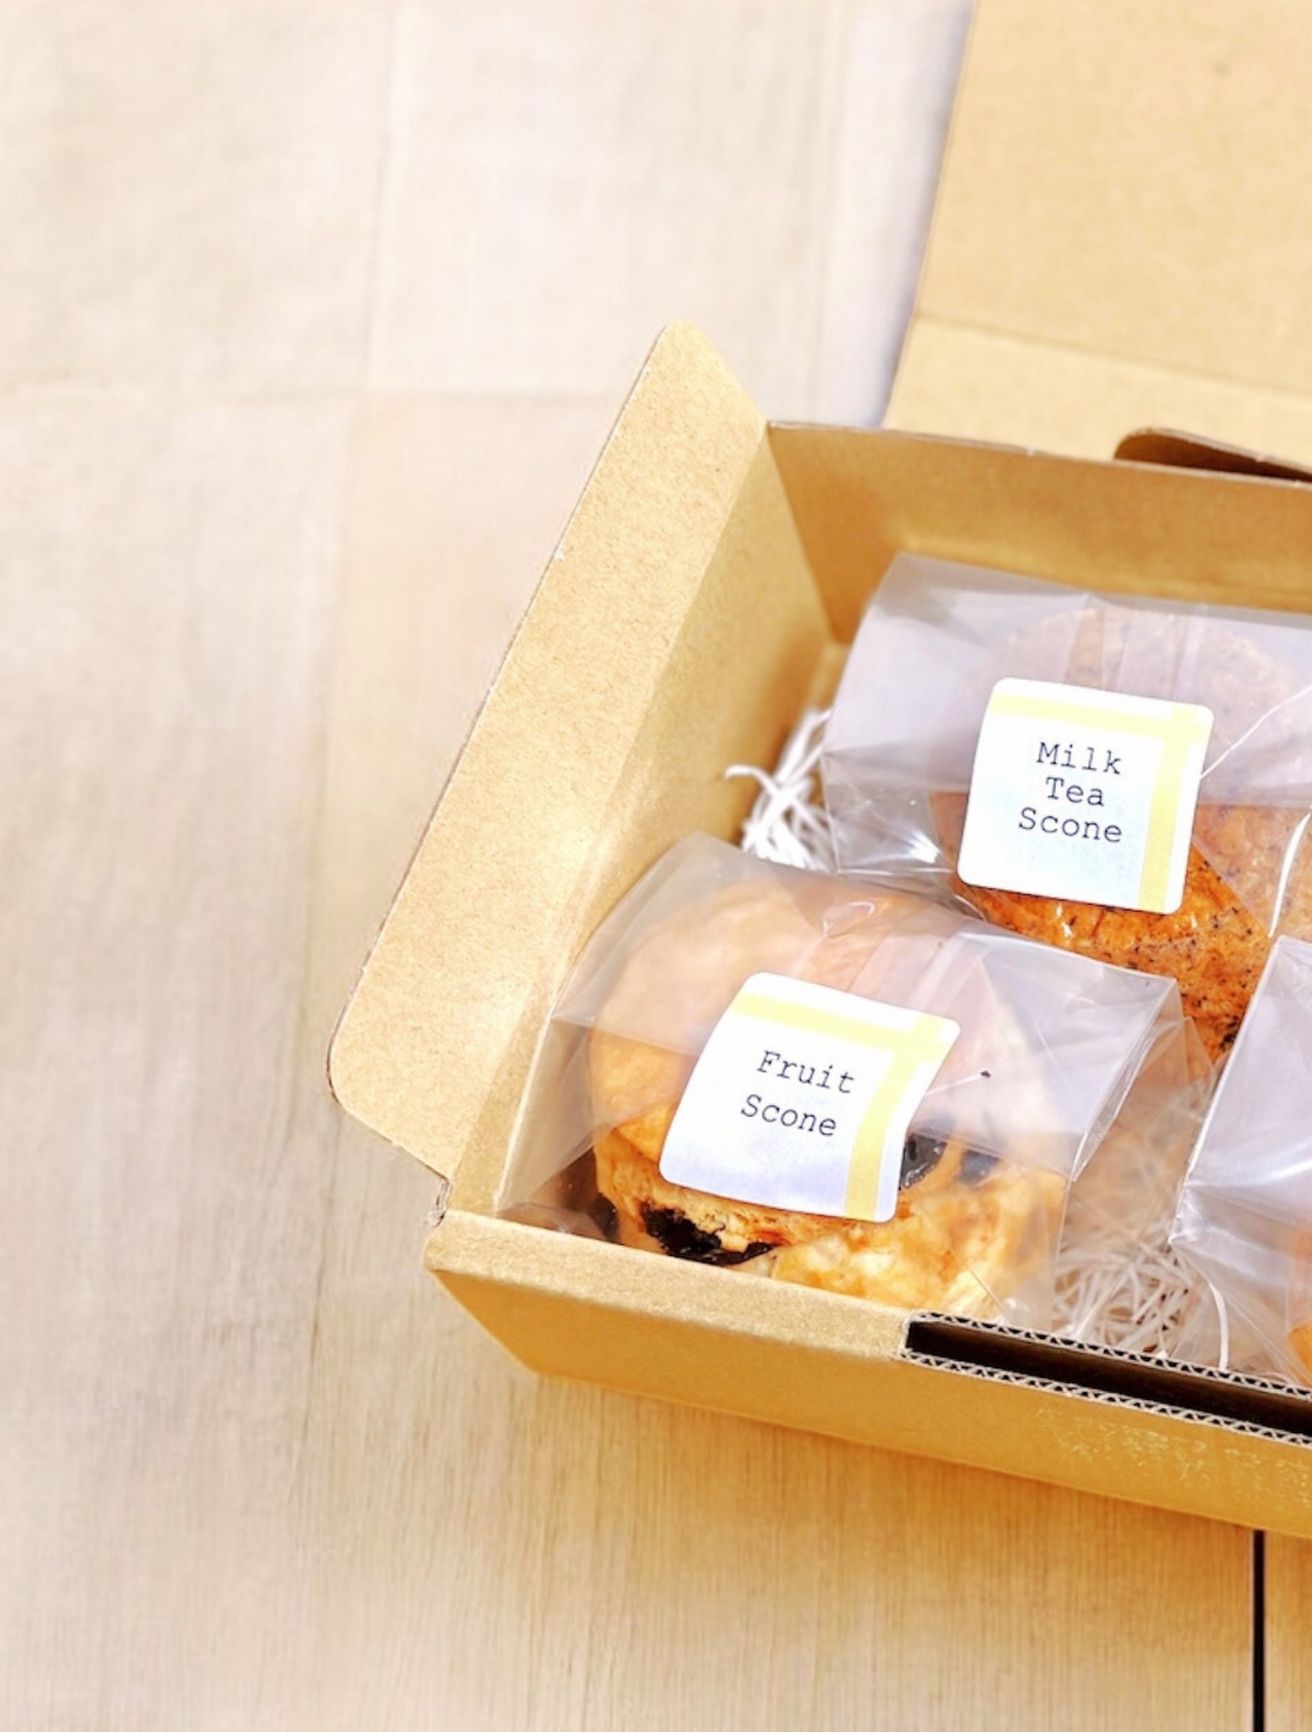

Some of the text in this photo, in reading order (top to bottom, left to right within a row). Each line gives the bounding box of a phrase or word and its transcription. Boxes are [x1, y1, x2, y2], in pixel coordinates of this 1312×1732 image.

[1036, 741, 1122, 775] Milk
[1046, 776, 1105, 807] Tea
[1018, 807, 1122, 843] Scone
[757, 1050, 855, 1094] Fruit
[740, 1094, 837, 1136] Scone
